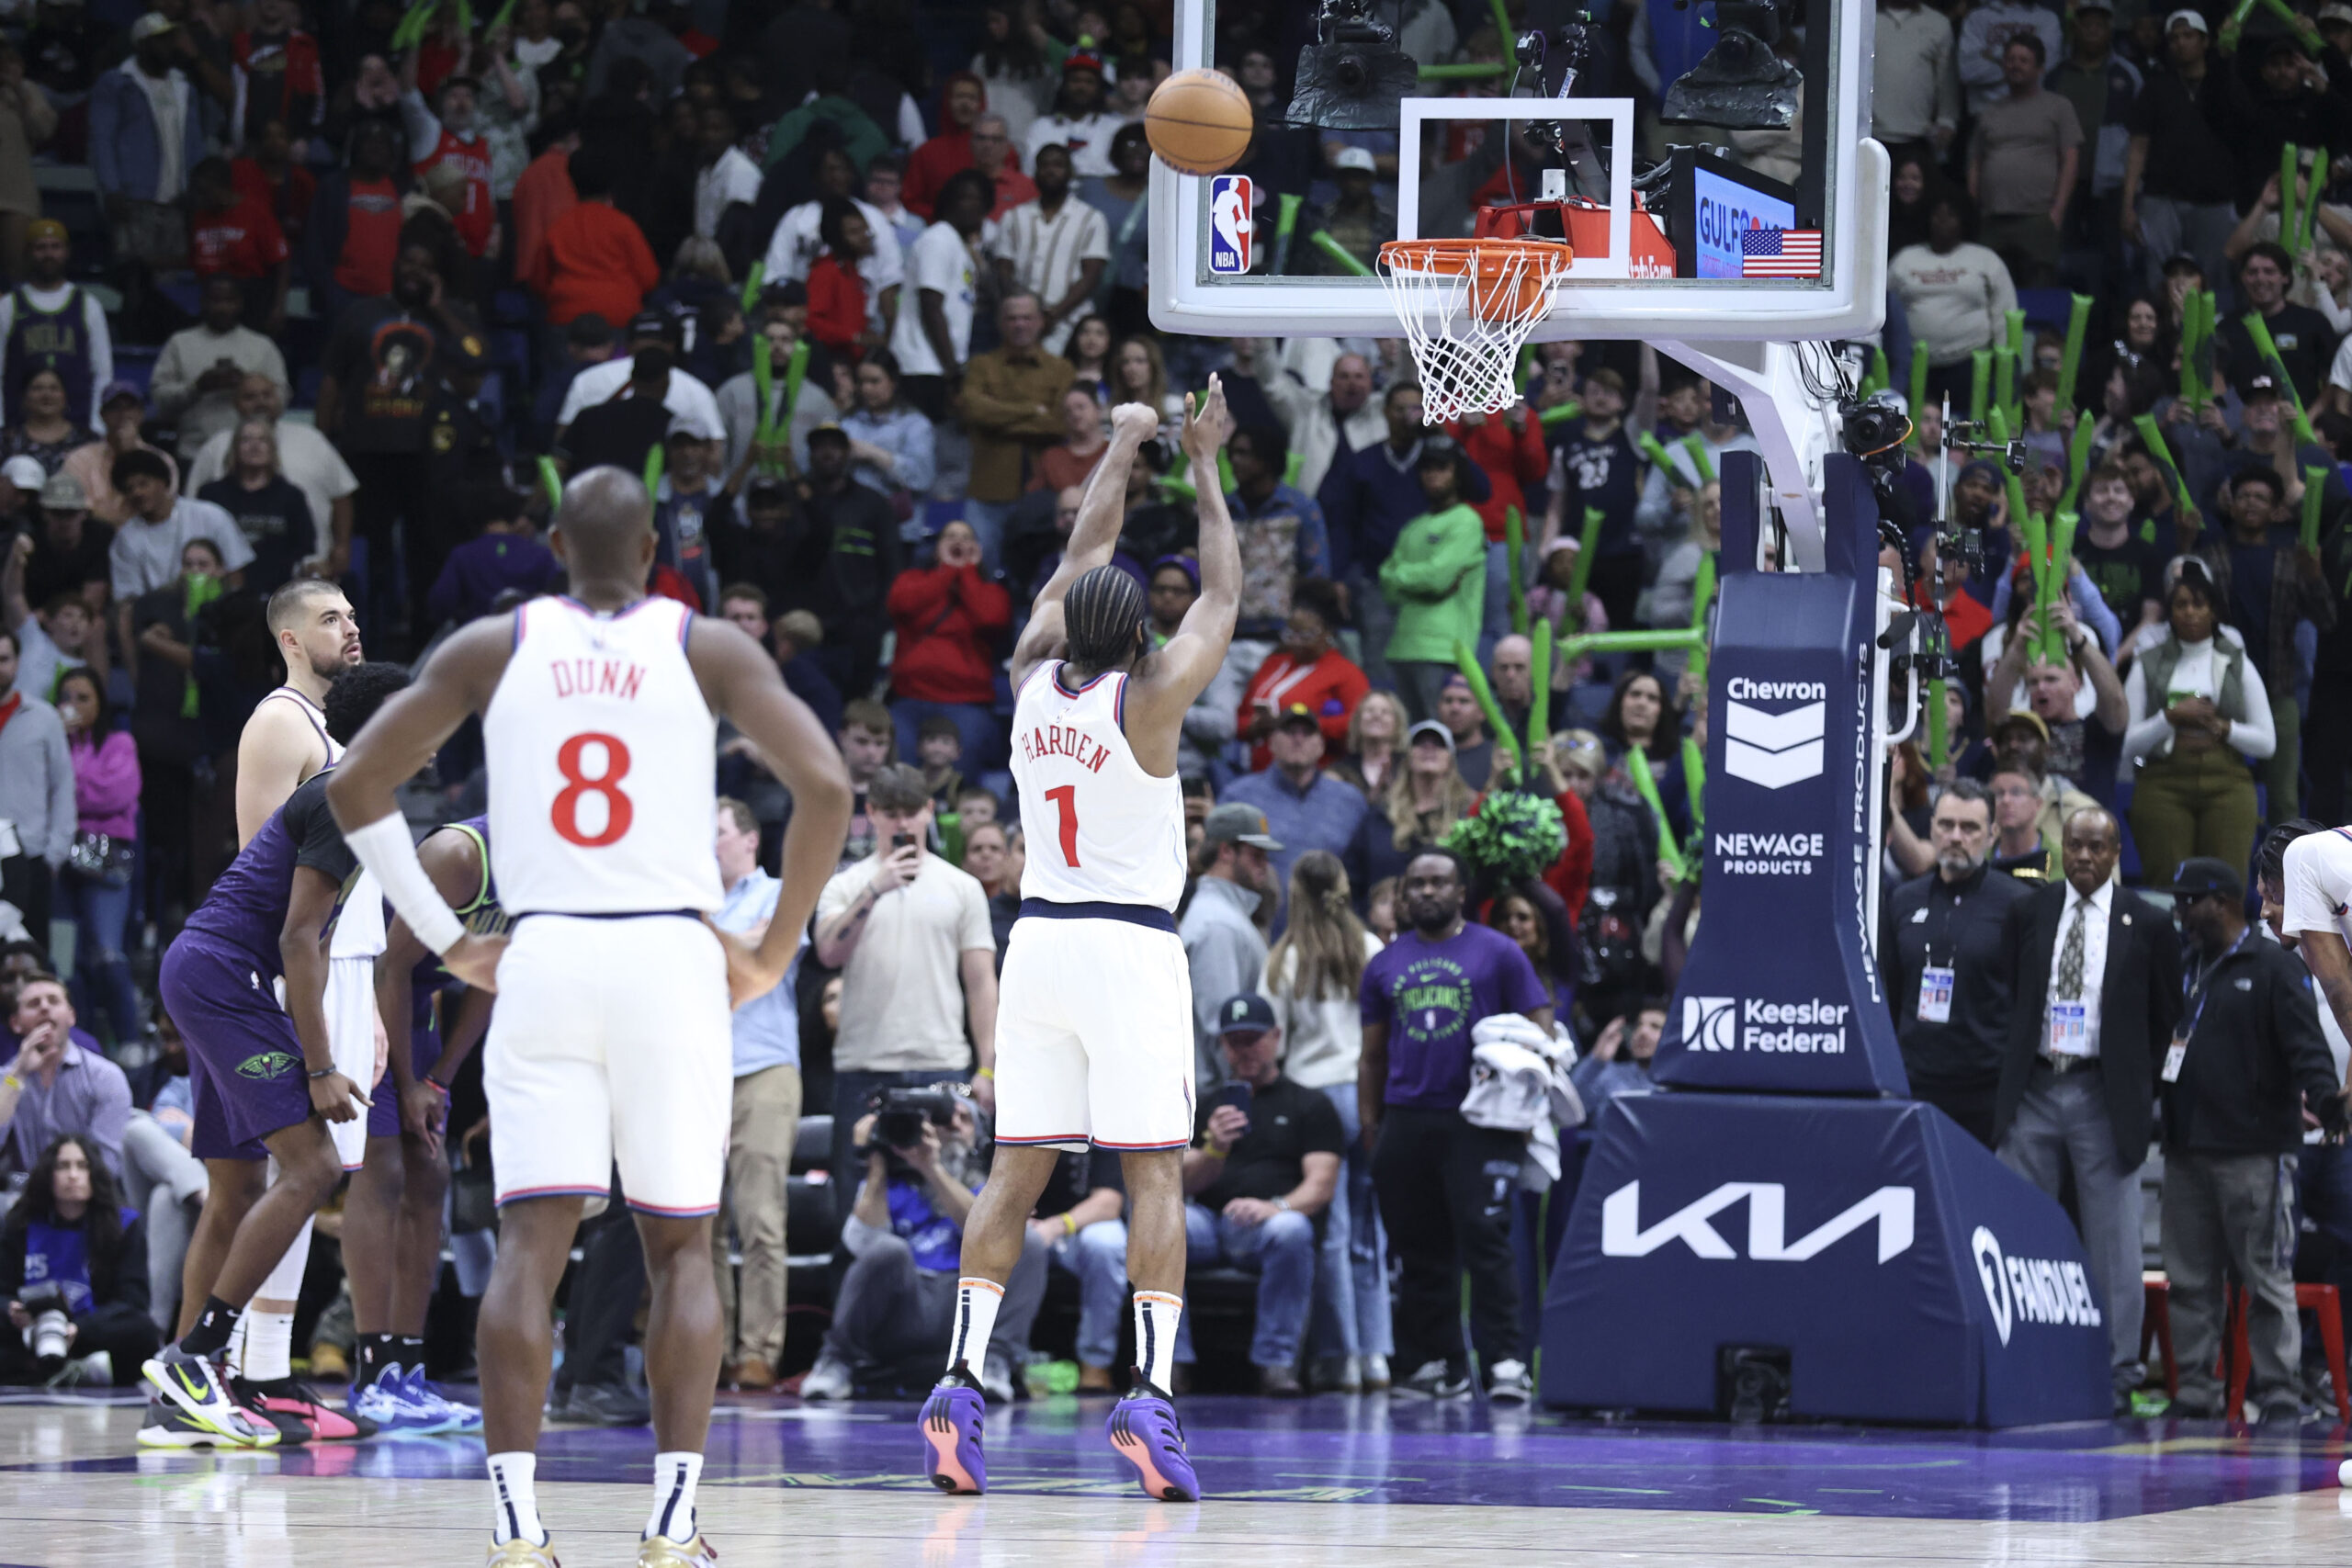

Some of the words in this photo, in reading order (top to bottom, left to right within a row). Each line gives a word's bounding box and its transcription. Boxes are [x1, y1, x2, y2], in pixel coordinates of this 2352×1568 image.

[1216, 252, 1235, 267] NBA
[550, 659, 646, 700] DUNN
[1727, 677, 1826, 700] Chevron
[1022, 725, 1110, 773] HARDEN
[1853, 642, 1868, 833] PRODUCTS
[551, 732, 633, 846] 8
[1045, 785, 1080, 867] 1
[1715, 833, 1823, 856] NEWAGE
[1724, 860, 1812, 874] PRODUCTS
[1744, 997, 1849, 1025] Keesler
[1743, 1025, 1846, 1054] Federal
[1601, 1179, 1915, 1265] KIA
[2006, 1256, 2101, 1326] FANDUEL
